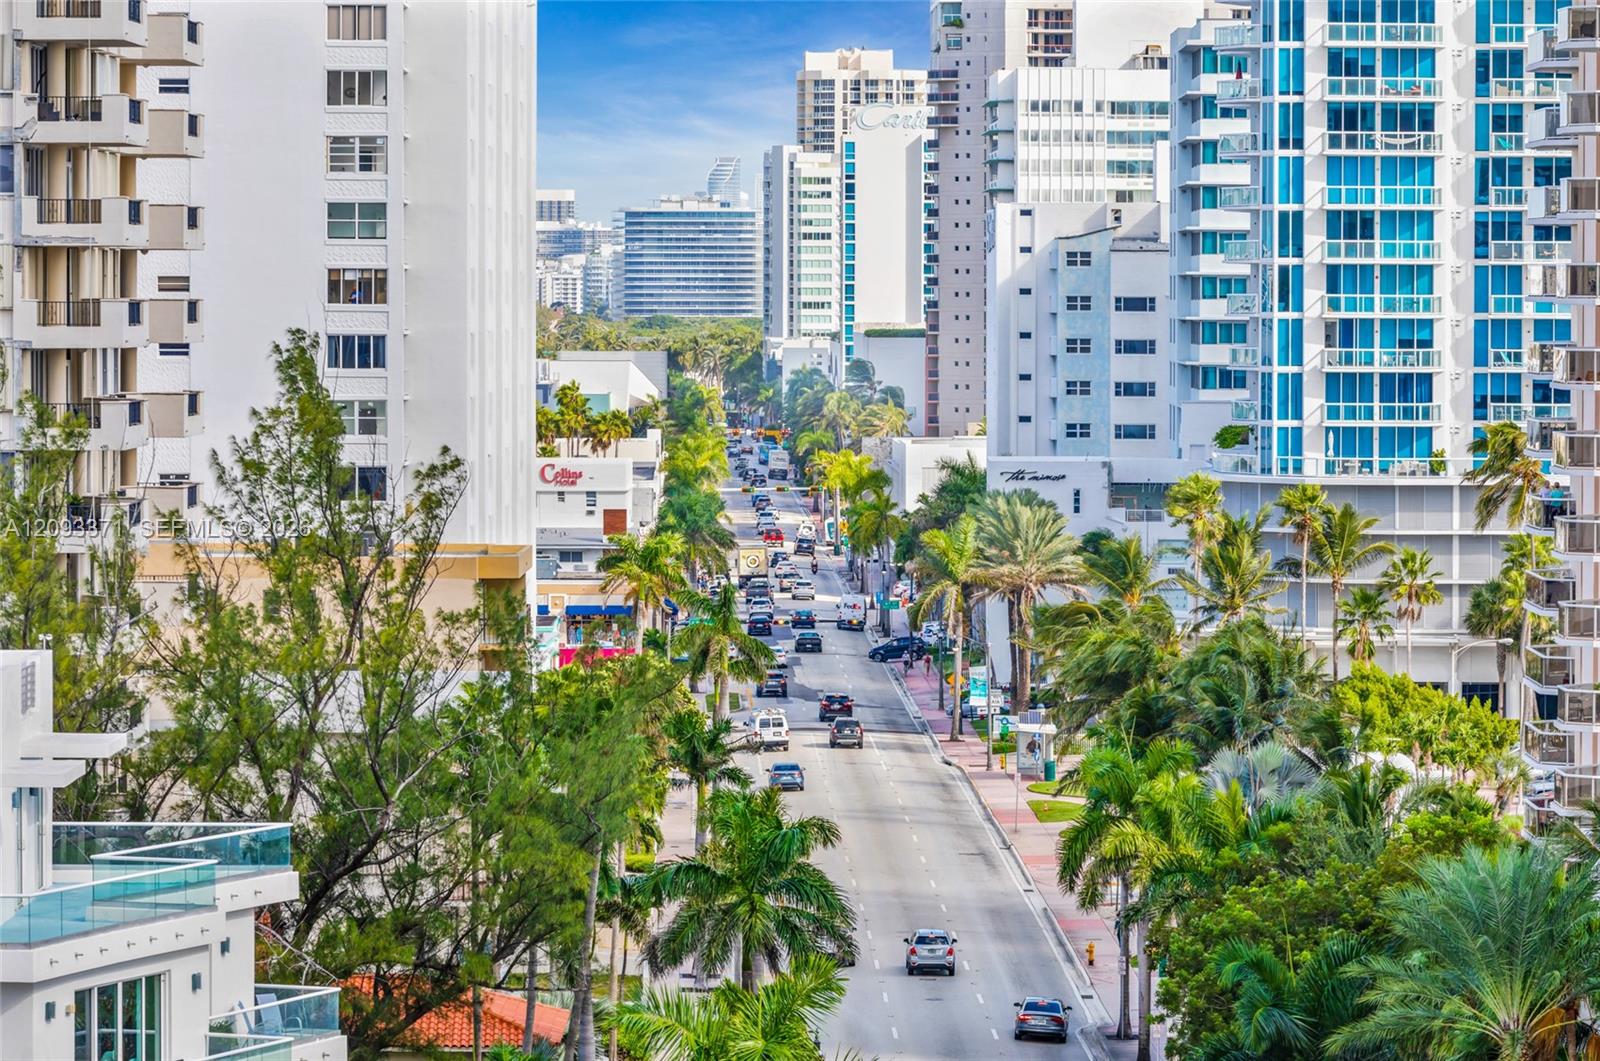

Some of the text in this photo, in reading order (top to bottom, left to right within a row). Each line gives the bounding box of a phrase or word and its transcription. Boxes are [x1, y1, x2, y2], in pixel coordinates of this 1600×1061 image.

[540, 463, 583, 484] Collins
[1000, 469, 1037, 482] The
[554, 479, 577, 487] Hotel
